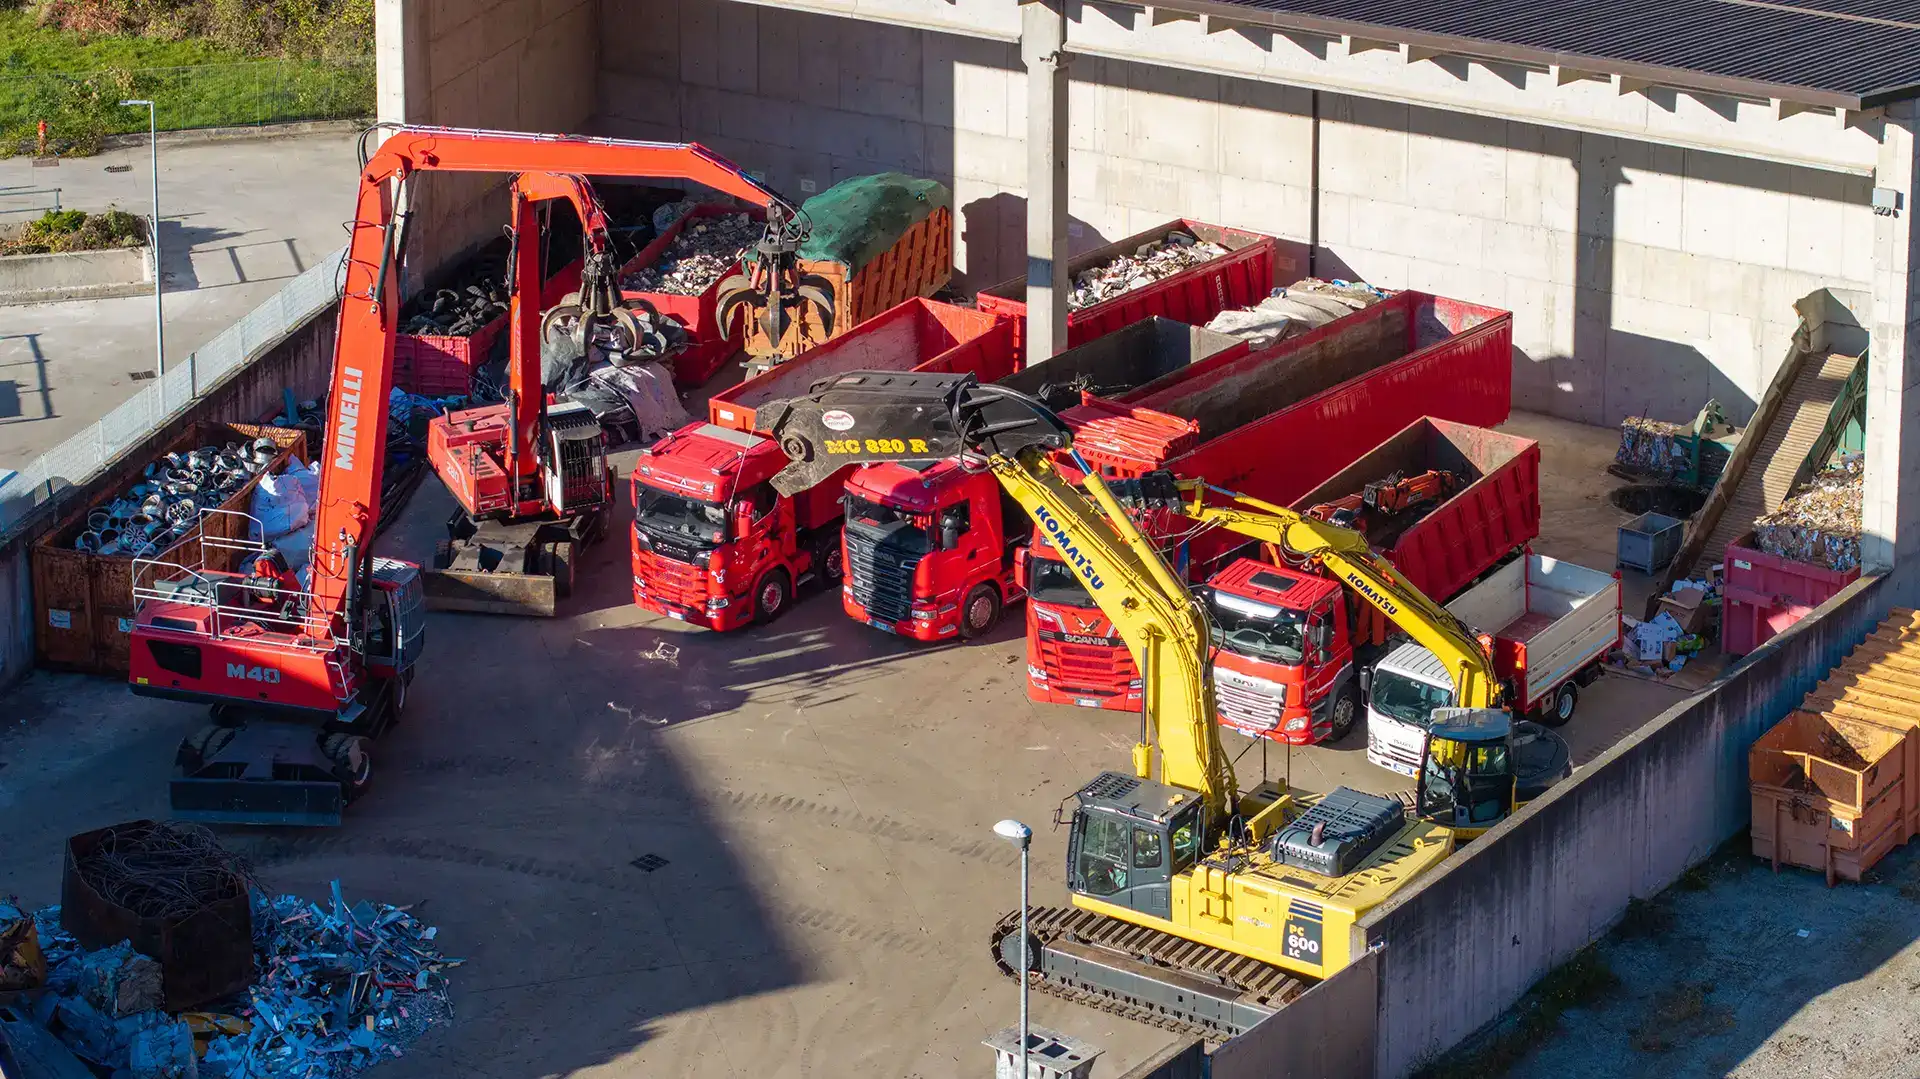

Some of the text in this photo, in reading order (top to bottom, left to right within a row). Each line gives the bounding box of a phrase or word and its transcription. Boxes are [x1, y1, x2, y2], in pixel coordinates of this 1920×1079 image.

[335, 365, 363, 471] MINELLI
[824, 439, 929, 454] MC 820 R
[1034, 504, 1105, 590] KOMATSU
[1347, 572, 1398, 615] KOMATSU
[1064, 633, 1110, 647] SCANIA
[226, 662, 281, 684] M40
[1289, 924, 1304, 936] PC
[1288, 934, 1319, 953] 600
[1289, 947, 1301, 958] LC
